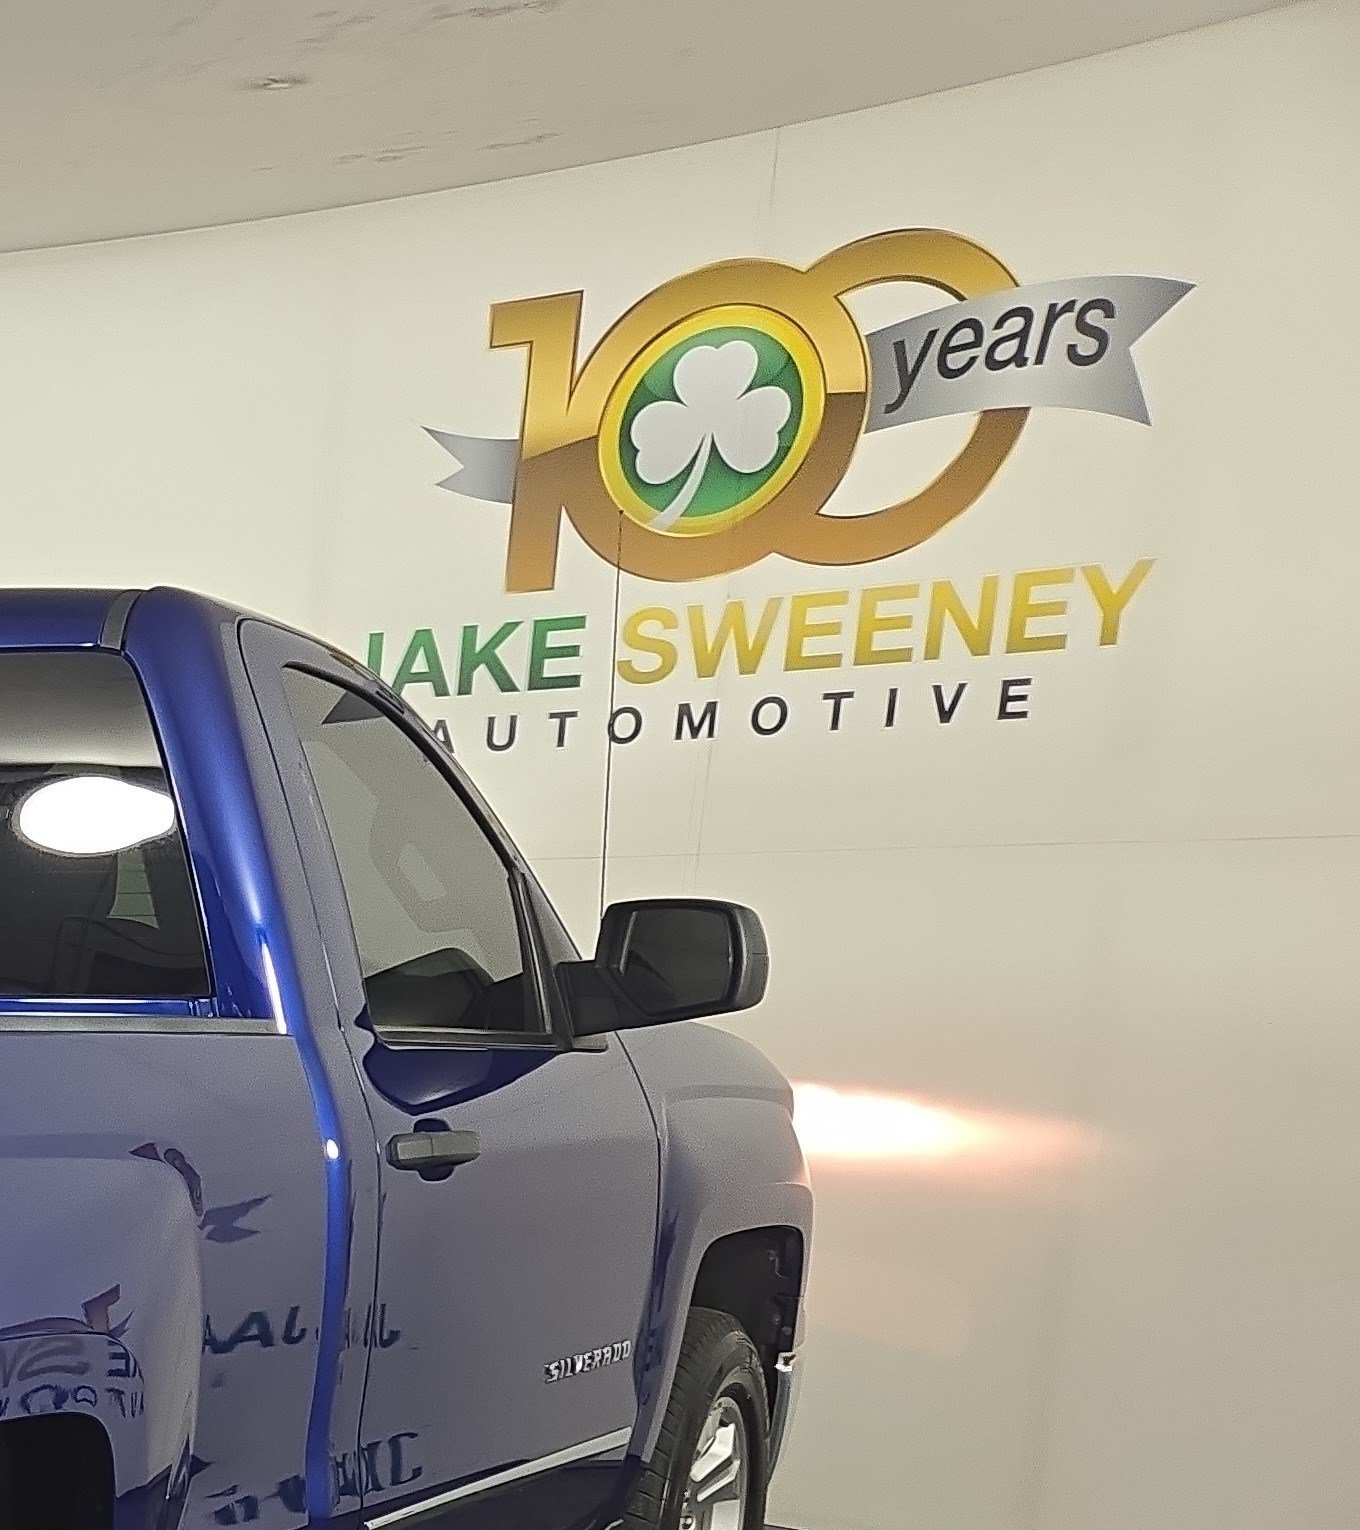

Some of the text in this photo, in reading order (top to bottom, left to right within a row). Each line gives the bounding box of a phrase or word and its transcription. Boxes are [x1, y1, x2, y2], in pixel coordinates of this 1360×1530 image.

[489, 227, 1031, 593] 100
[882, 296, 1117, 413] years
[615, 557, 1157, 686] SWEENEY
[433, 676, 1034, 753] AUTOMOTIVE
[545, 1340, 632, 1383] SILVERADO
